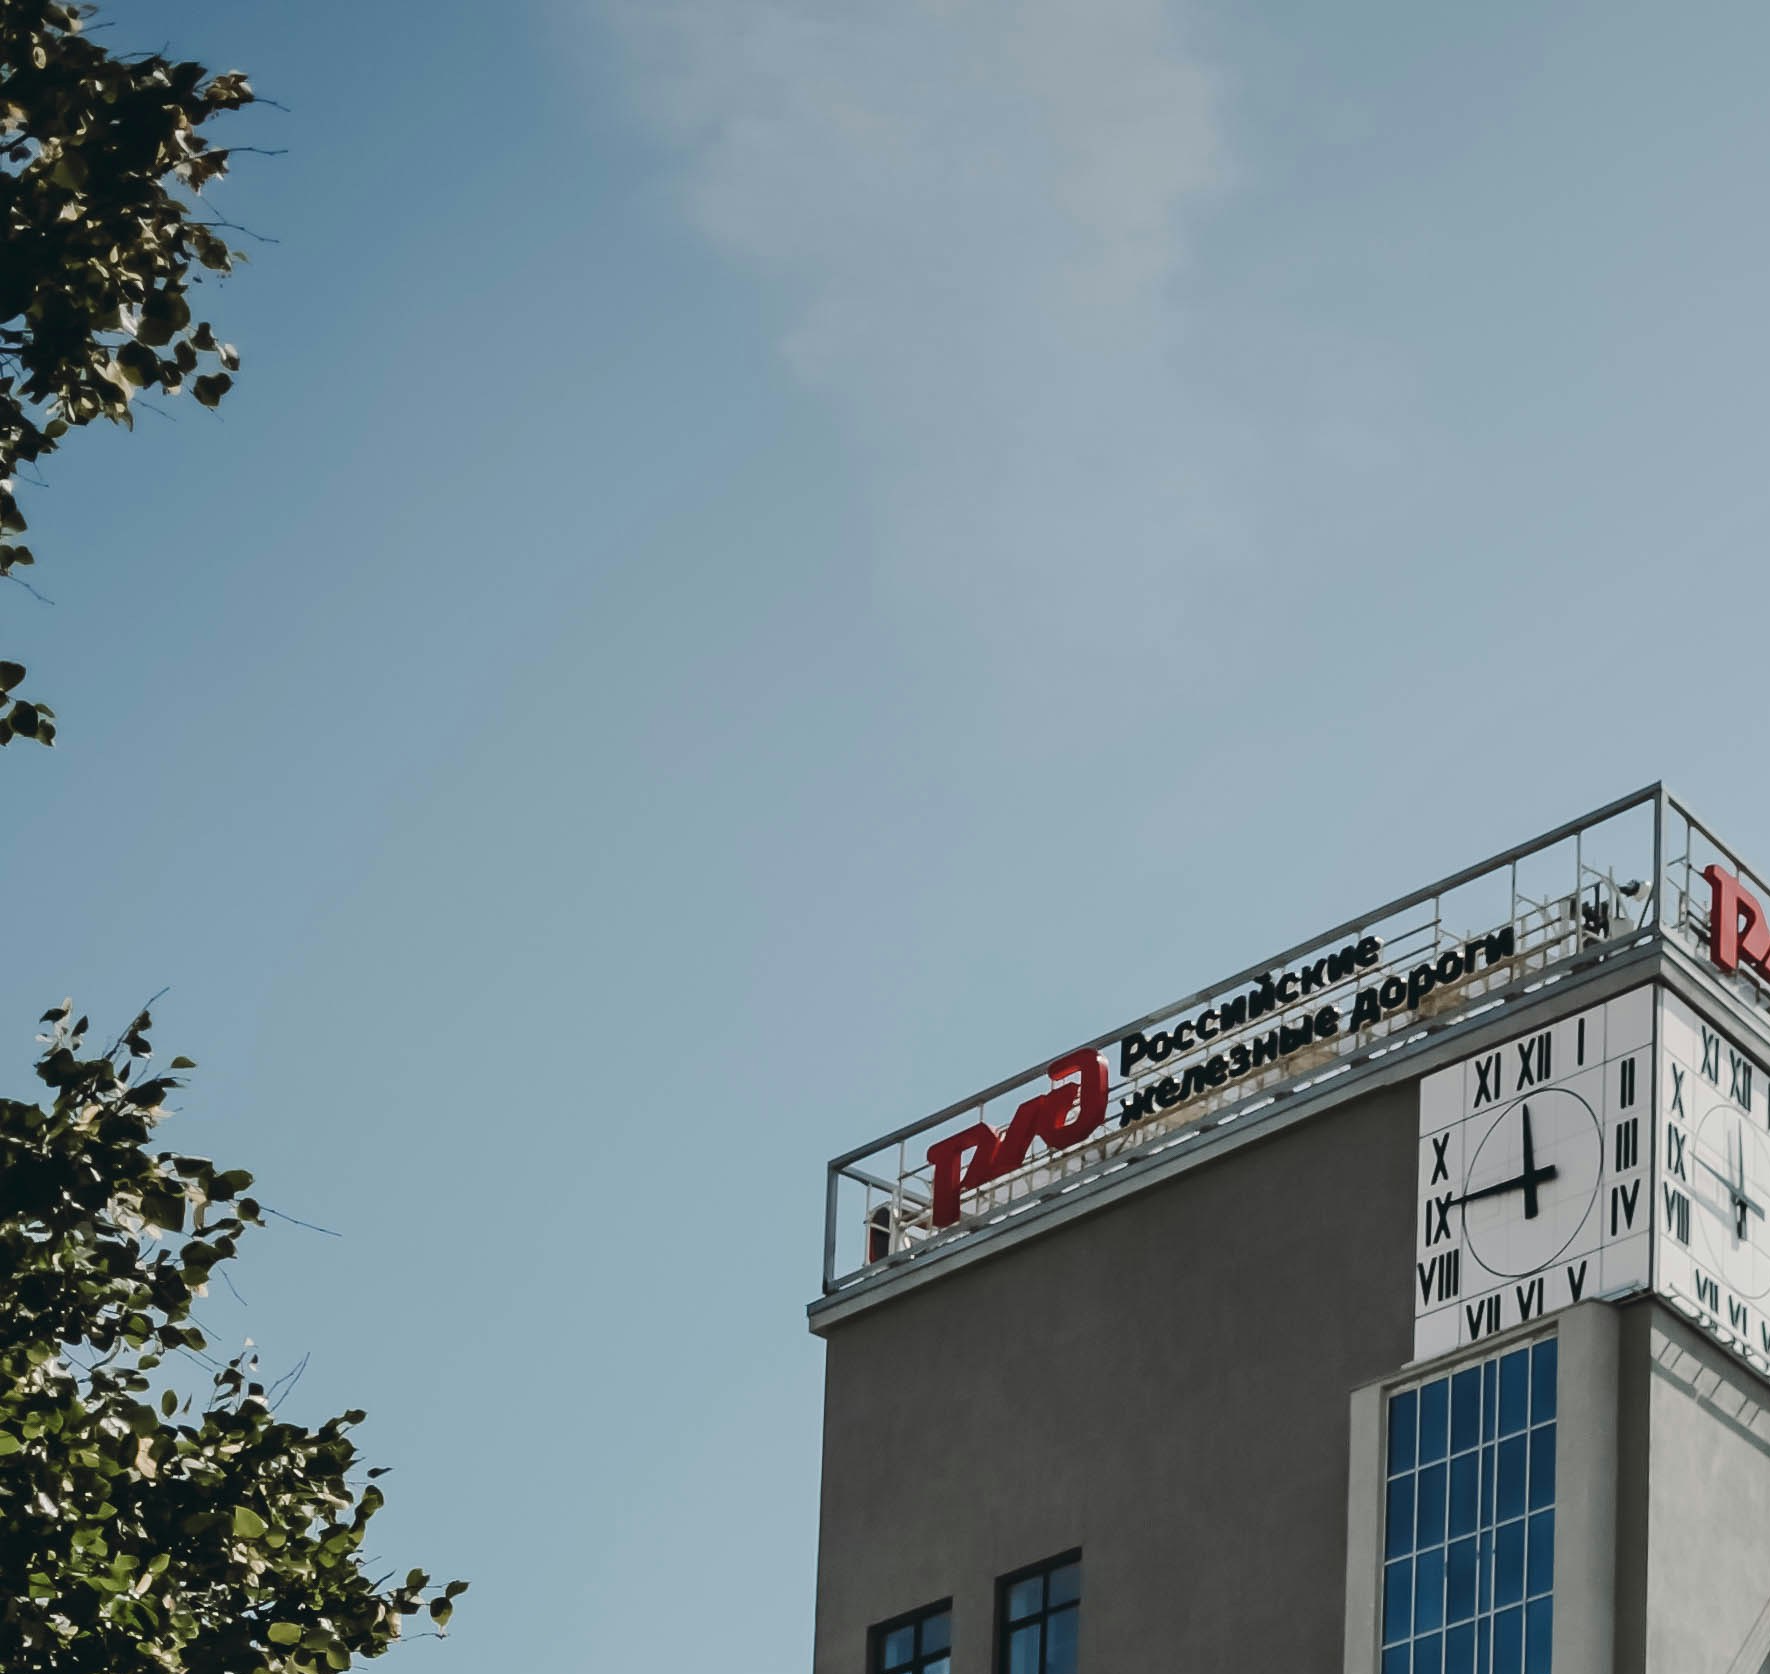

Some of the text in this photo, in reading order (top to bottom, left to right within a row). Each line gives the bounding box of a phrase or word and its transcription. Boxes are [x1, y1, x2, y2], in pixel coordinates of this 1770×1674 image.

[1119, 927, 1514, 1128] железные дороги
[1121, 936, 1382, 1076] Российские
[1517, 1031, 1551, 1091] XII
[1578, 1018, 1585, 1066] I
[1701, 1025, 1719, 1086] XI
[1474, 1052, 1501, 1108] XI
[1621, 1057, 1635, 1109] II
[1671, 1062, 1685, 1118] X
[1729, 1049, 1752, 1113] XII
[1431, 1132, 1450, 1186] X
[1616, 1117, 1638, 1172] III
[1668, 1121, 1686, 1181] IX
[1425, 1191, 1452, 1247] IX
[1611, 1178, 1640, 1236] IV
[1664, 1181, 1689, 1247] VIII
[1417, 1249, 1460, 1306] VIII
[1516, 1277, 1544, 1321] VI
[1567, 1260, 1587, 1302] V
[1695, 1268, 1719, 1314] VII
[1466, 1294, 1501, 1340] VII
[1728, 1294, 1747, 1337] VI
